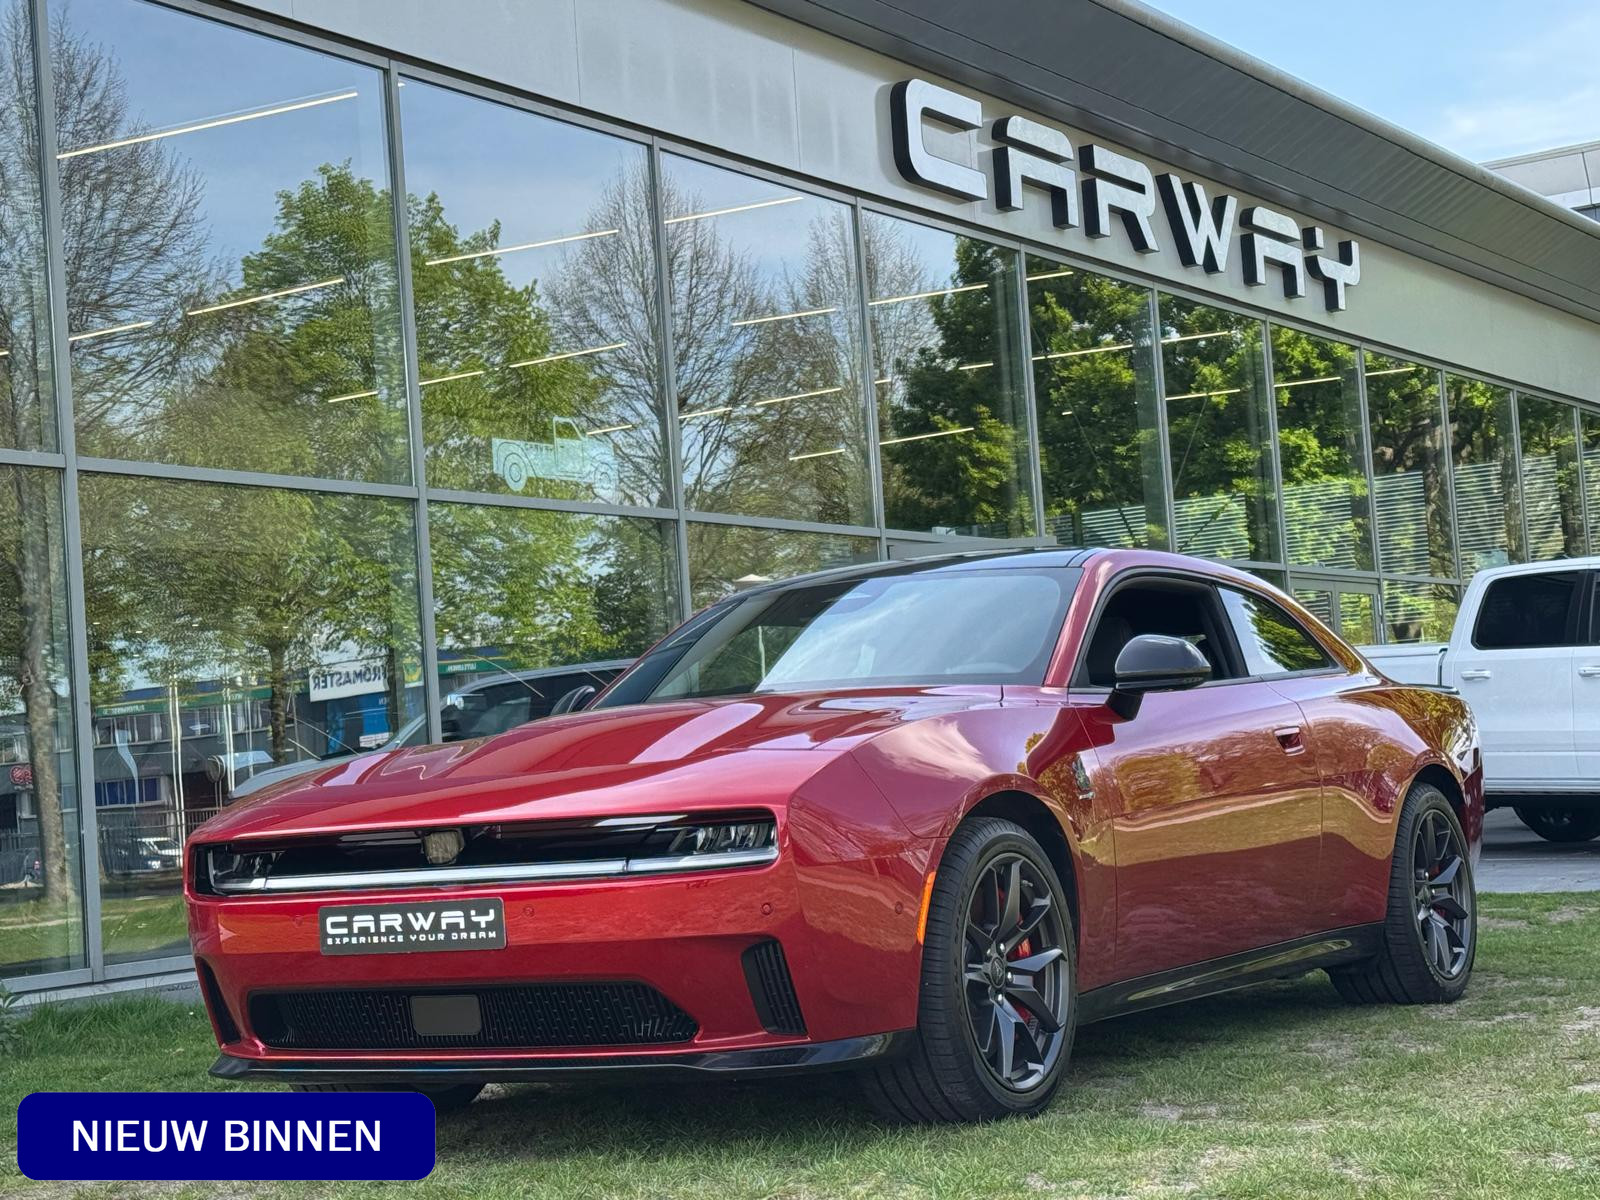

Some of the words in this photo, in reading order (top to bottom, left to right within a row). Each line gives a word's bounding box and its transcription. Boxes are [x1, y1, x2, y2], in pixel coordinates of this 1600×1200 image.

[890, 78, 1361, 312] CARWAY
[326, 909, 495, 934] CARWAY
[327, 934, 404, 945] EXPERIENCE
[409, 933, 445, 942] YOUR
[451, 931, 497, 940] DREAM
